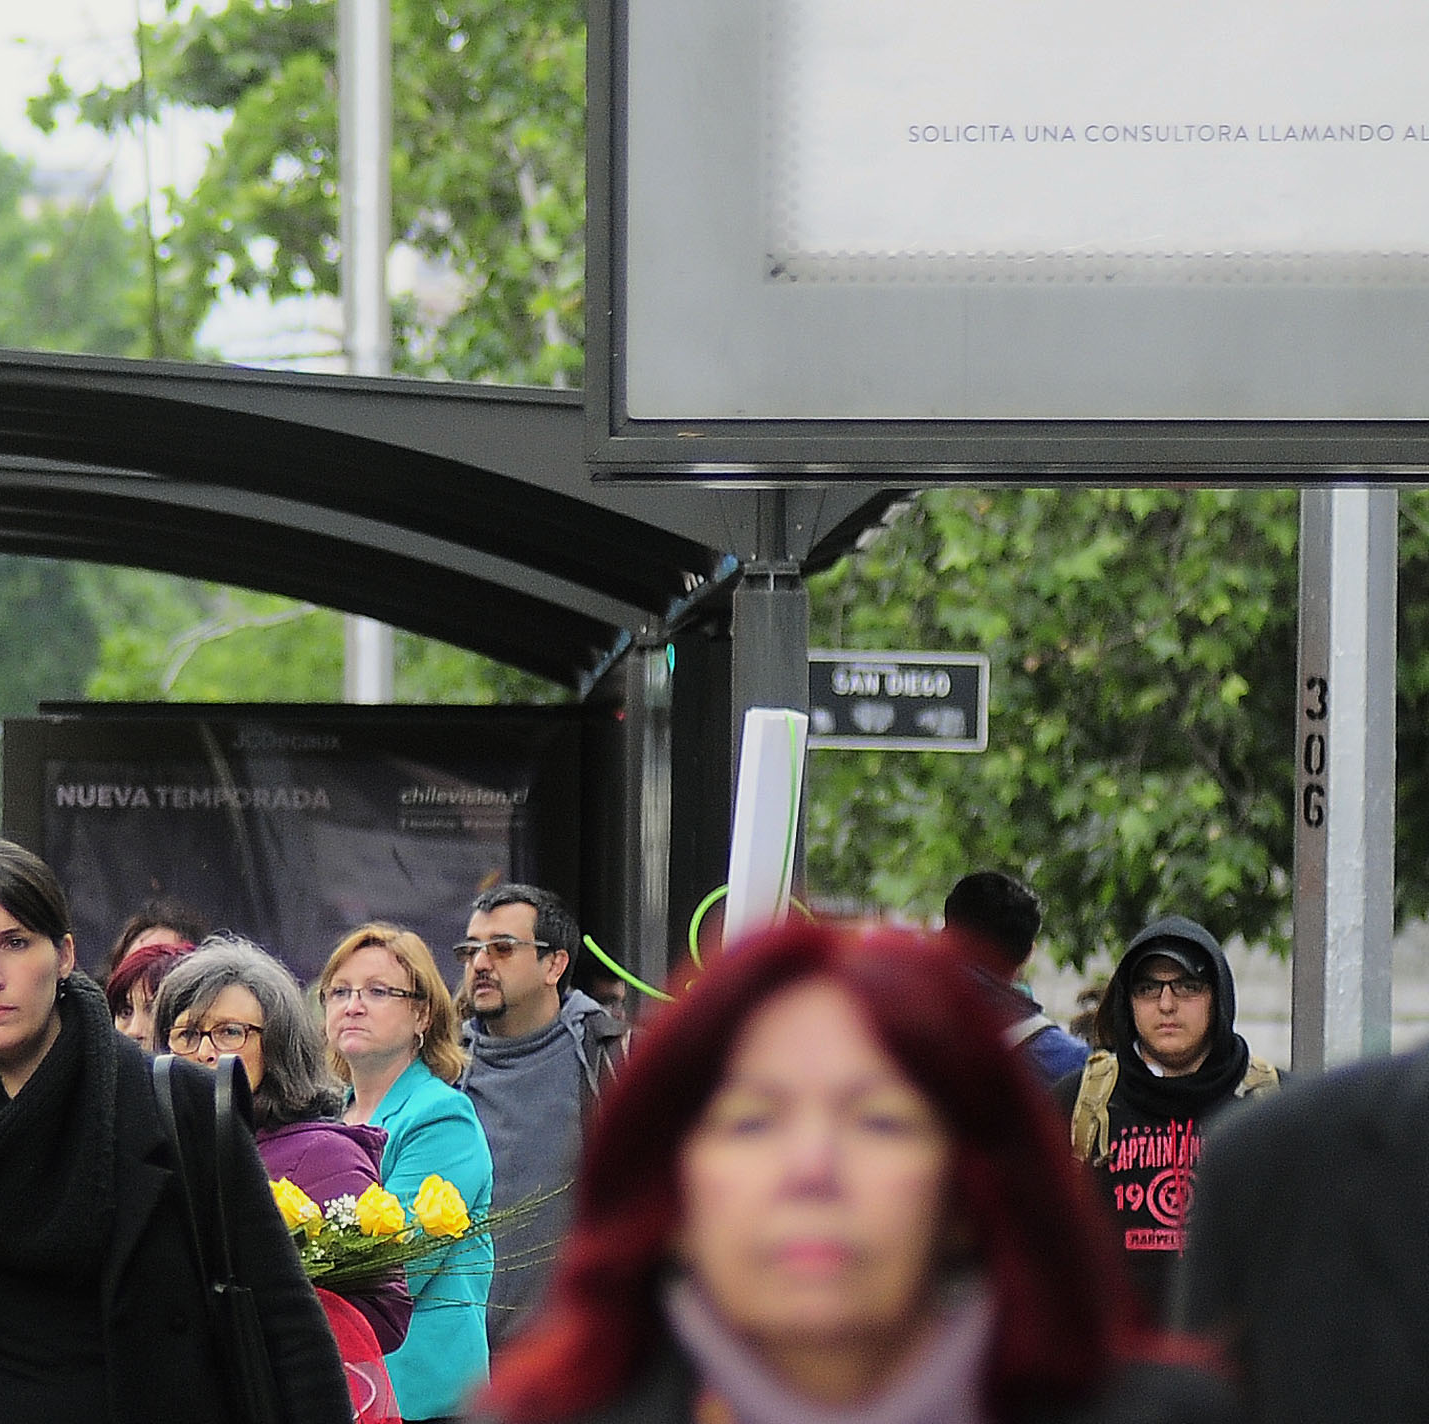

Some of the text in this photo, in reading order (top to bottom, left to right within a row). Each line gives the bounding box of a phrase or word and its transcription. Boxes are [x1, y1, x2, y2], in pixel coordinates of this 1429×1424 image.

[907, 123, 1429, 143] SOLICITA UNA CONSULTORA LLAMANDO AL
[831, 668, 951, 698] SAN DIEGO
[1303, 676, 1328, 829] 306
[55, 785, 333, 811] NUEVA TEMPORADA
[1108, 1135, 1174, 1173] CAPTAIN
